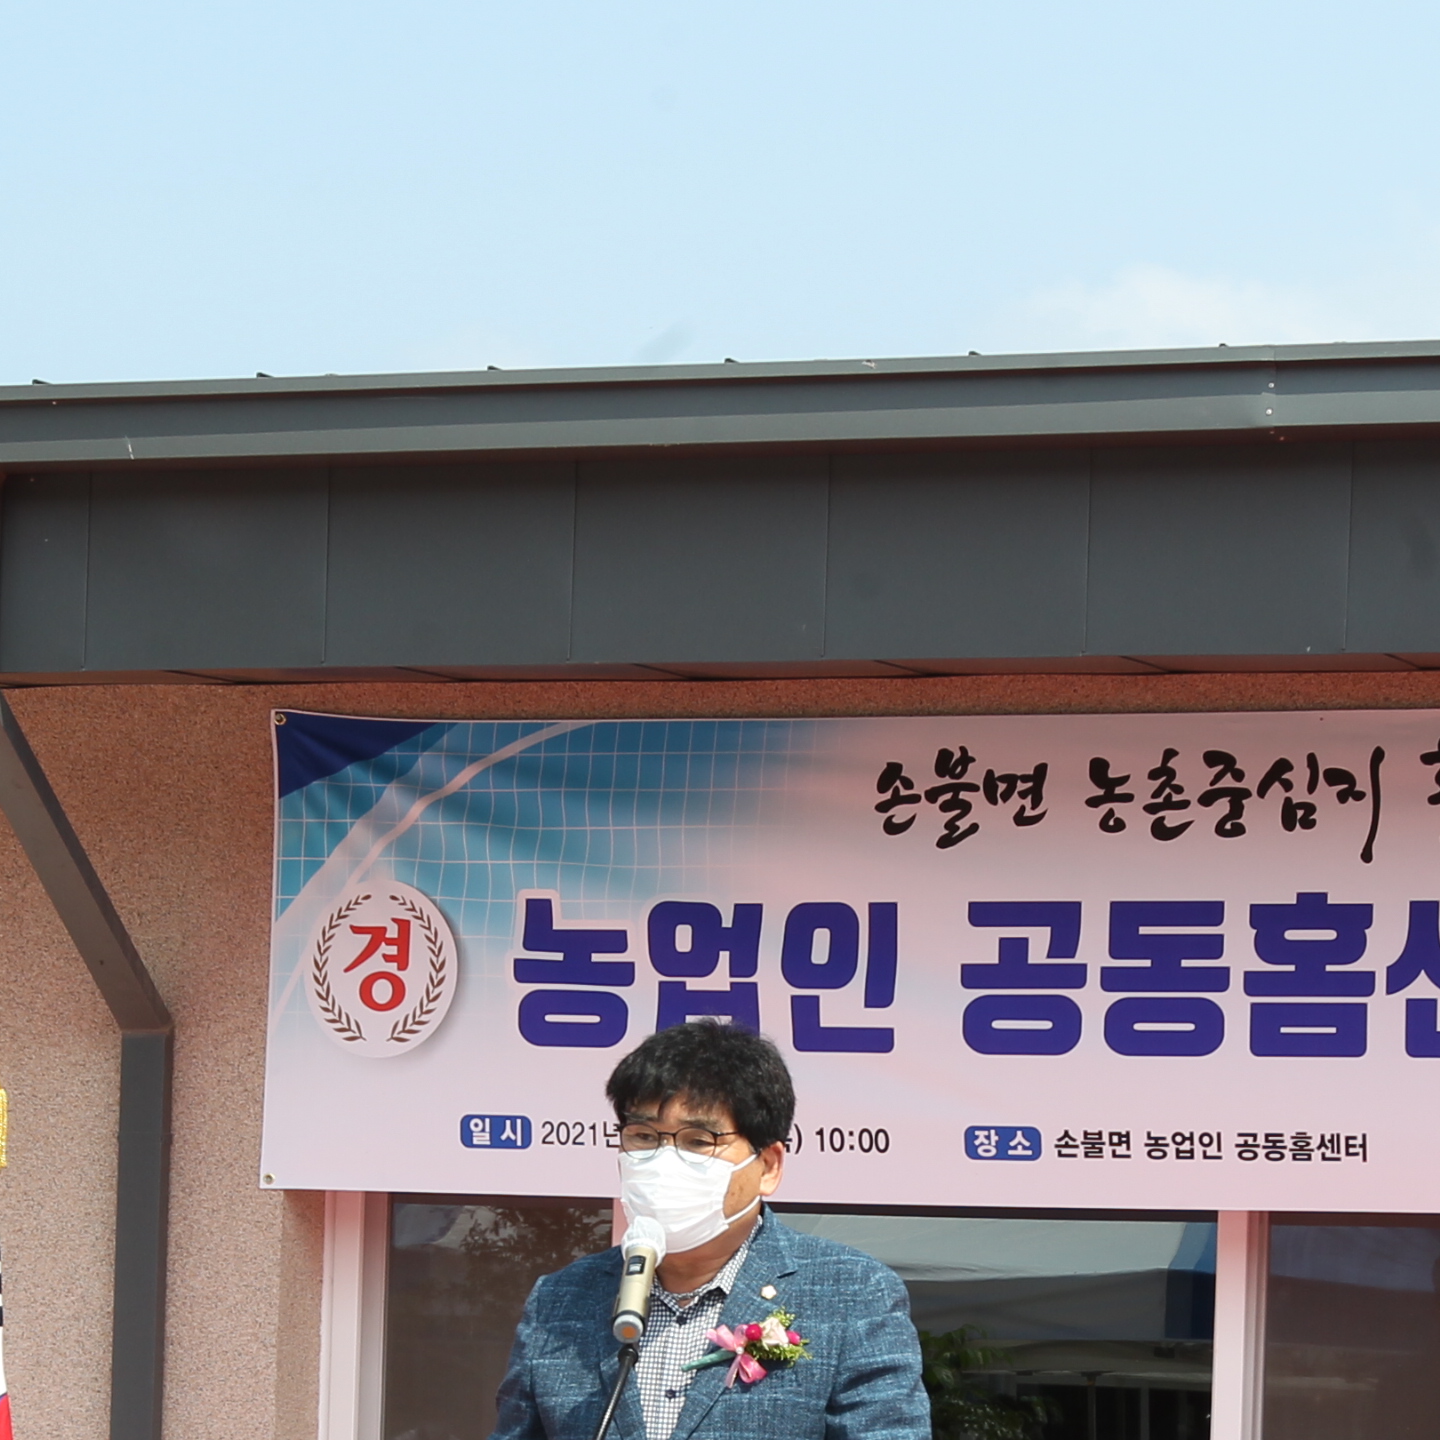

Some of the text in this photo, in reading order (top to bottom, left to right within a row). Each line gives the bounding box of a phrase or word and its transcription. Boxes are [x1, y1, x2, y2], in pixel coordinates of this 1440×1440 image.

[873, 745, 1049, 850] 손불면
[1084, 745, 1386, 864] 농촌중심지
[343, 917, 411, 1012] 경
[513, 897, 898, 1054] 농업인
[814, 1126, 890, 1154] 10:00
[1054, 1129, 1132, 1159] 손불면
[1144, 1131, 1224, 1160] 농업인
[1234, 1131, 1368, 1163] 공동홈센터
